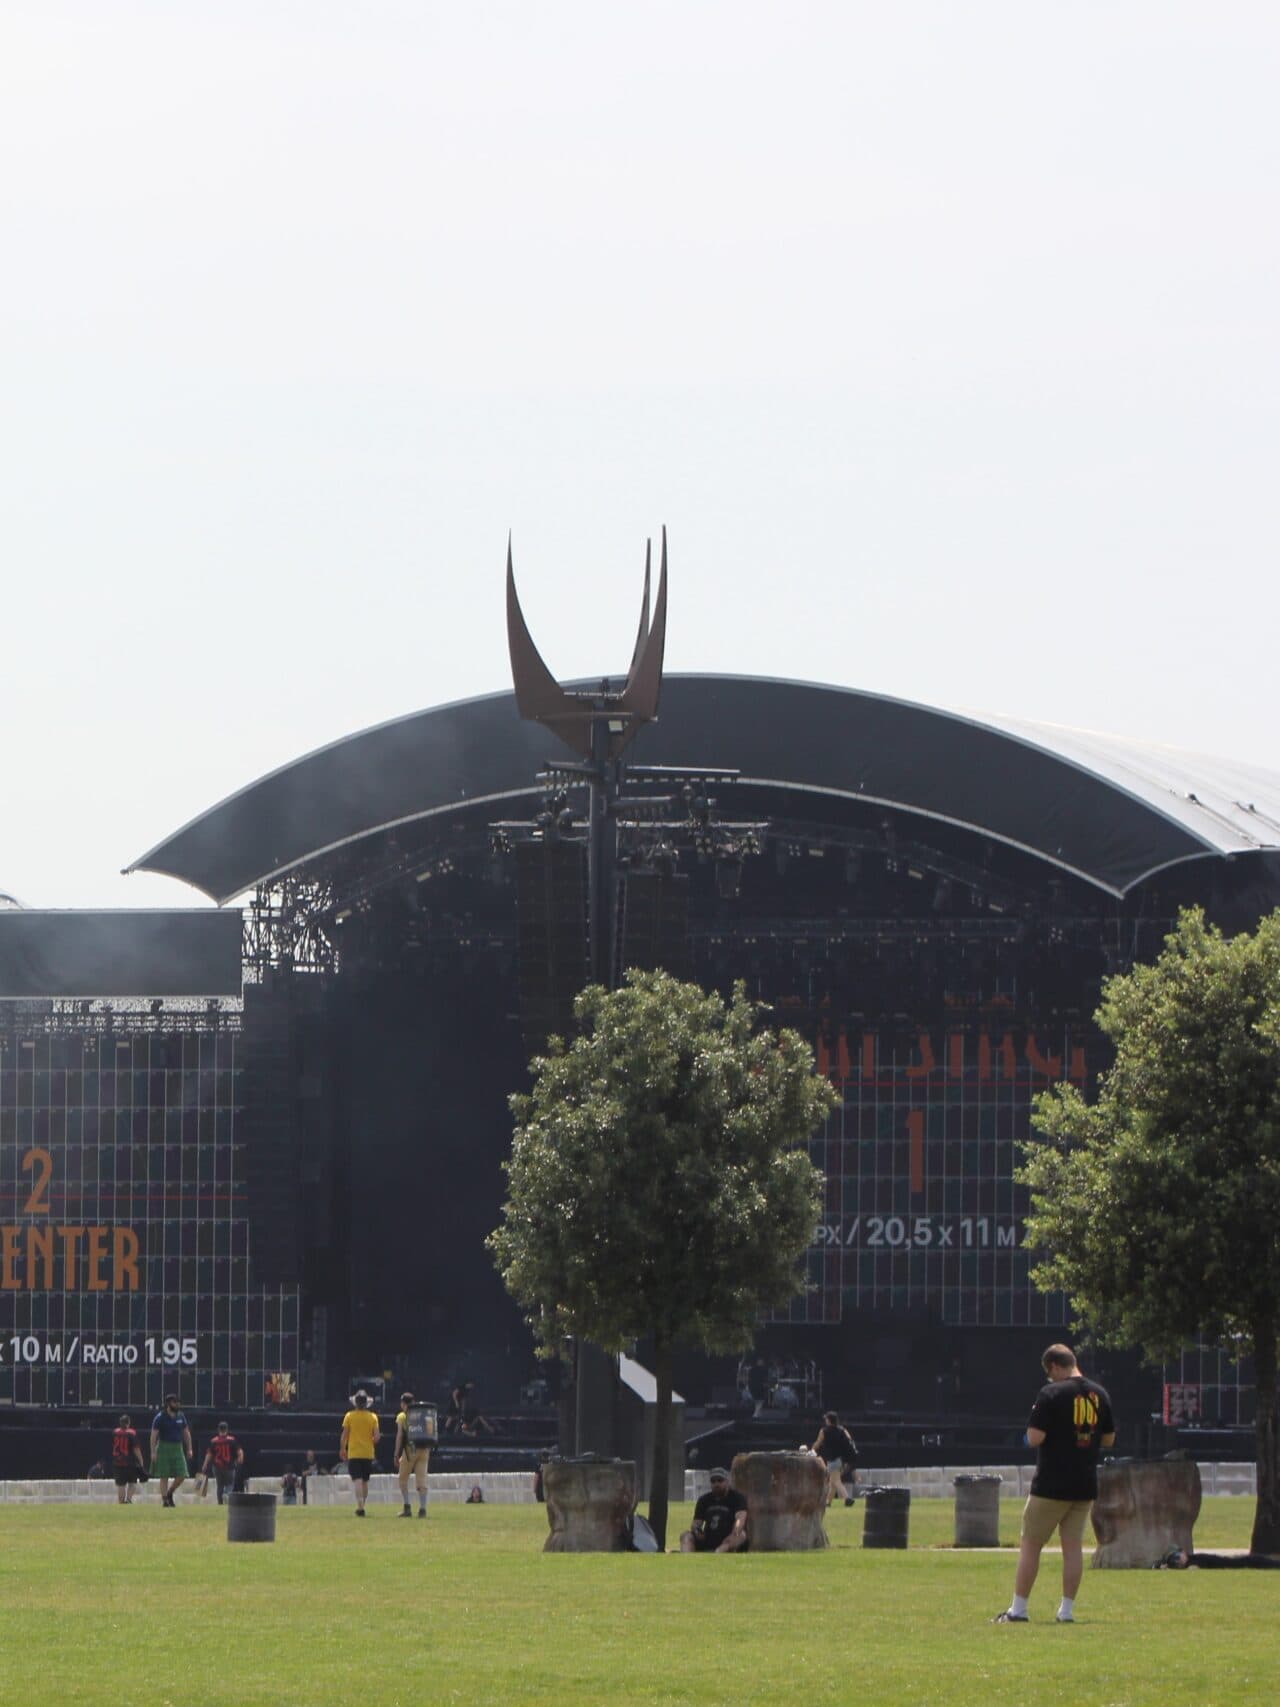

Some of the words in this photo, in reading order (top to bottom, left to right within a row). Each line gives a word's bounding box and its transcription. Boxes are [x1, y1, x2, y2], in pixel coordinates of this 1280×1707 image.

[905, 1111, 924, 1193] 1
[22, 1147, 53, 1213] 2
[866, 1218, 933, 1250] 20,5
[960, 1219, 989, 1246] 11
[997, 1227, 1015, 1247] M
[10, 1336, 39, 1362] 10
[45, 1343, 61, 1363] M
[66, 1337, 79, 1364] /
[83, 1344, 138, 1364] RATIO
[144, 1337, 198, 1365] 1.95
